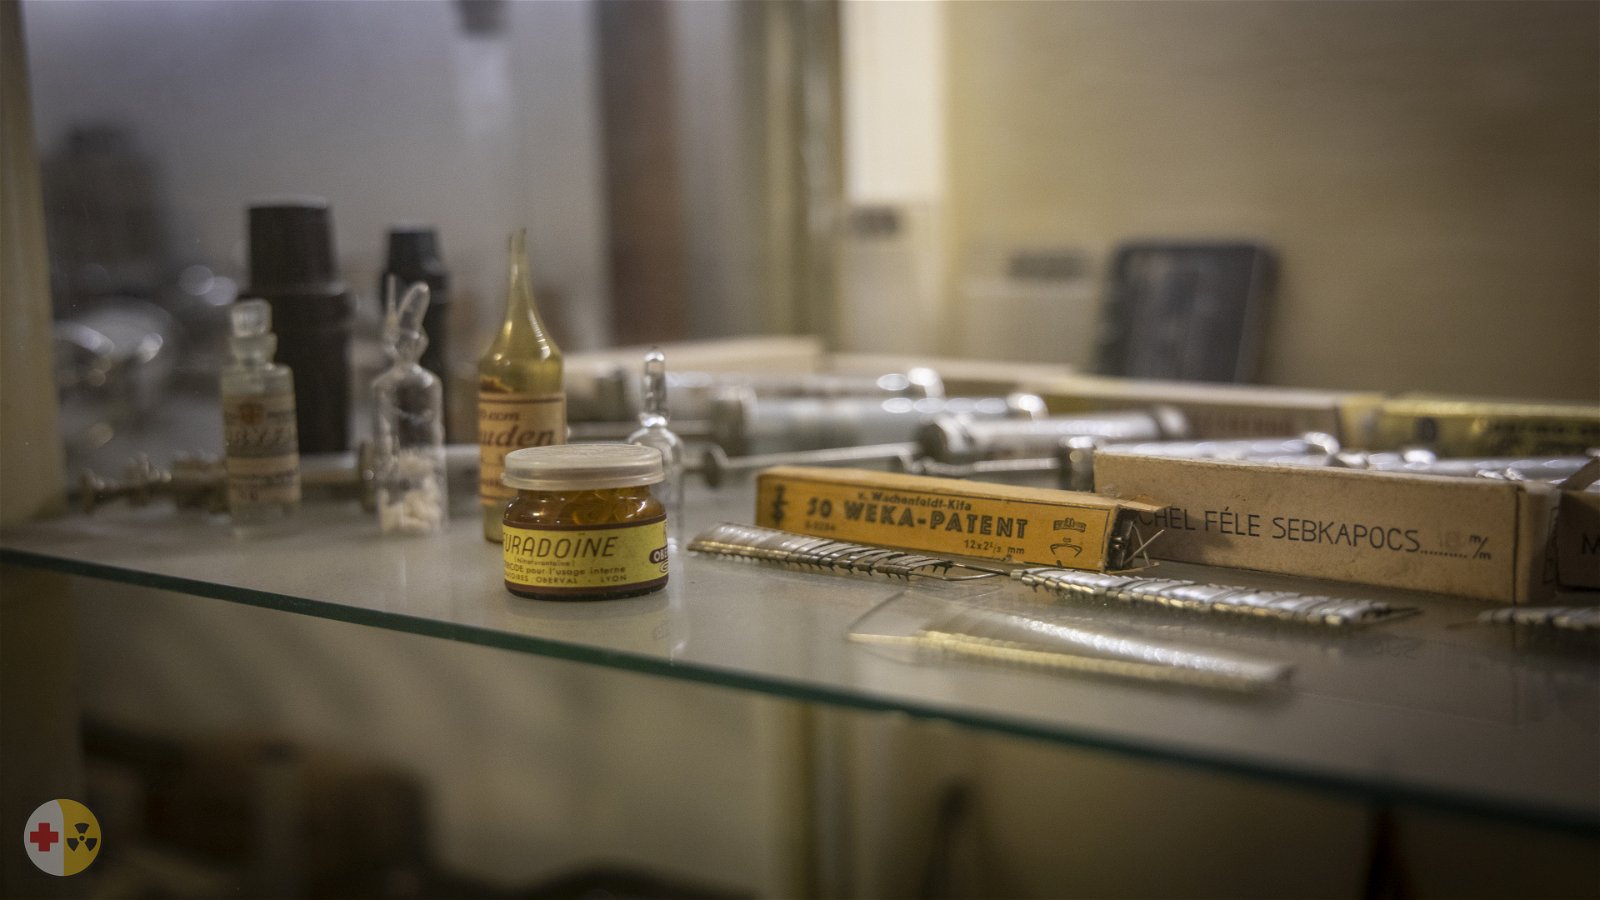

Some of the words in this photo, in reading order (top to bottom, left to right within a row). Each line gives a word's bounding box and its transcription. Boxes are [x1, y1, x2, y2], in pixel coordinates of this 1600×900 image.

[843, 499, 1028, 539] WEKA-PATENT
[1204, 506, 1261, 537] FÉLE
[503, 532, 619, 559] URADOÏNE
[1007, 546, 1025, 556] mm
[590, 567, 626, 575] interne
[601, 574, 627, 583] LYON
